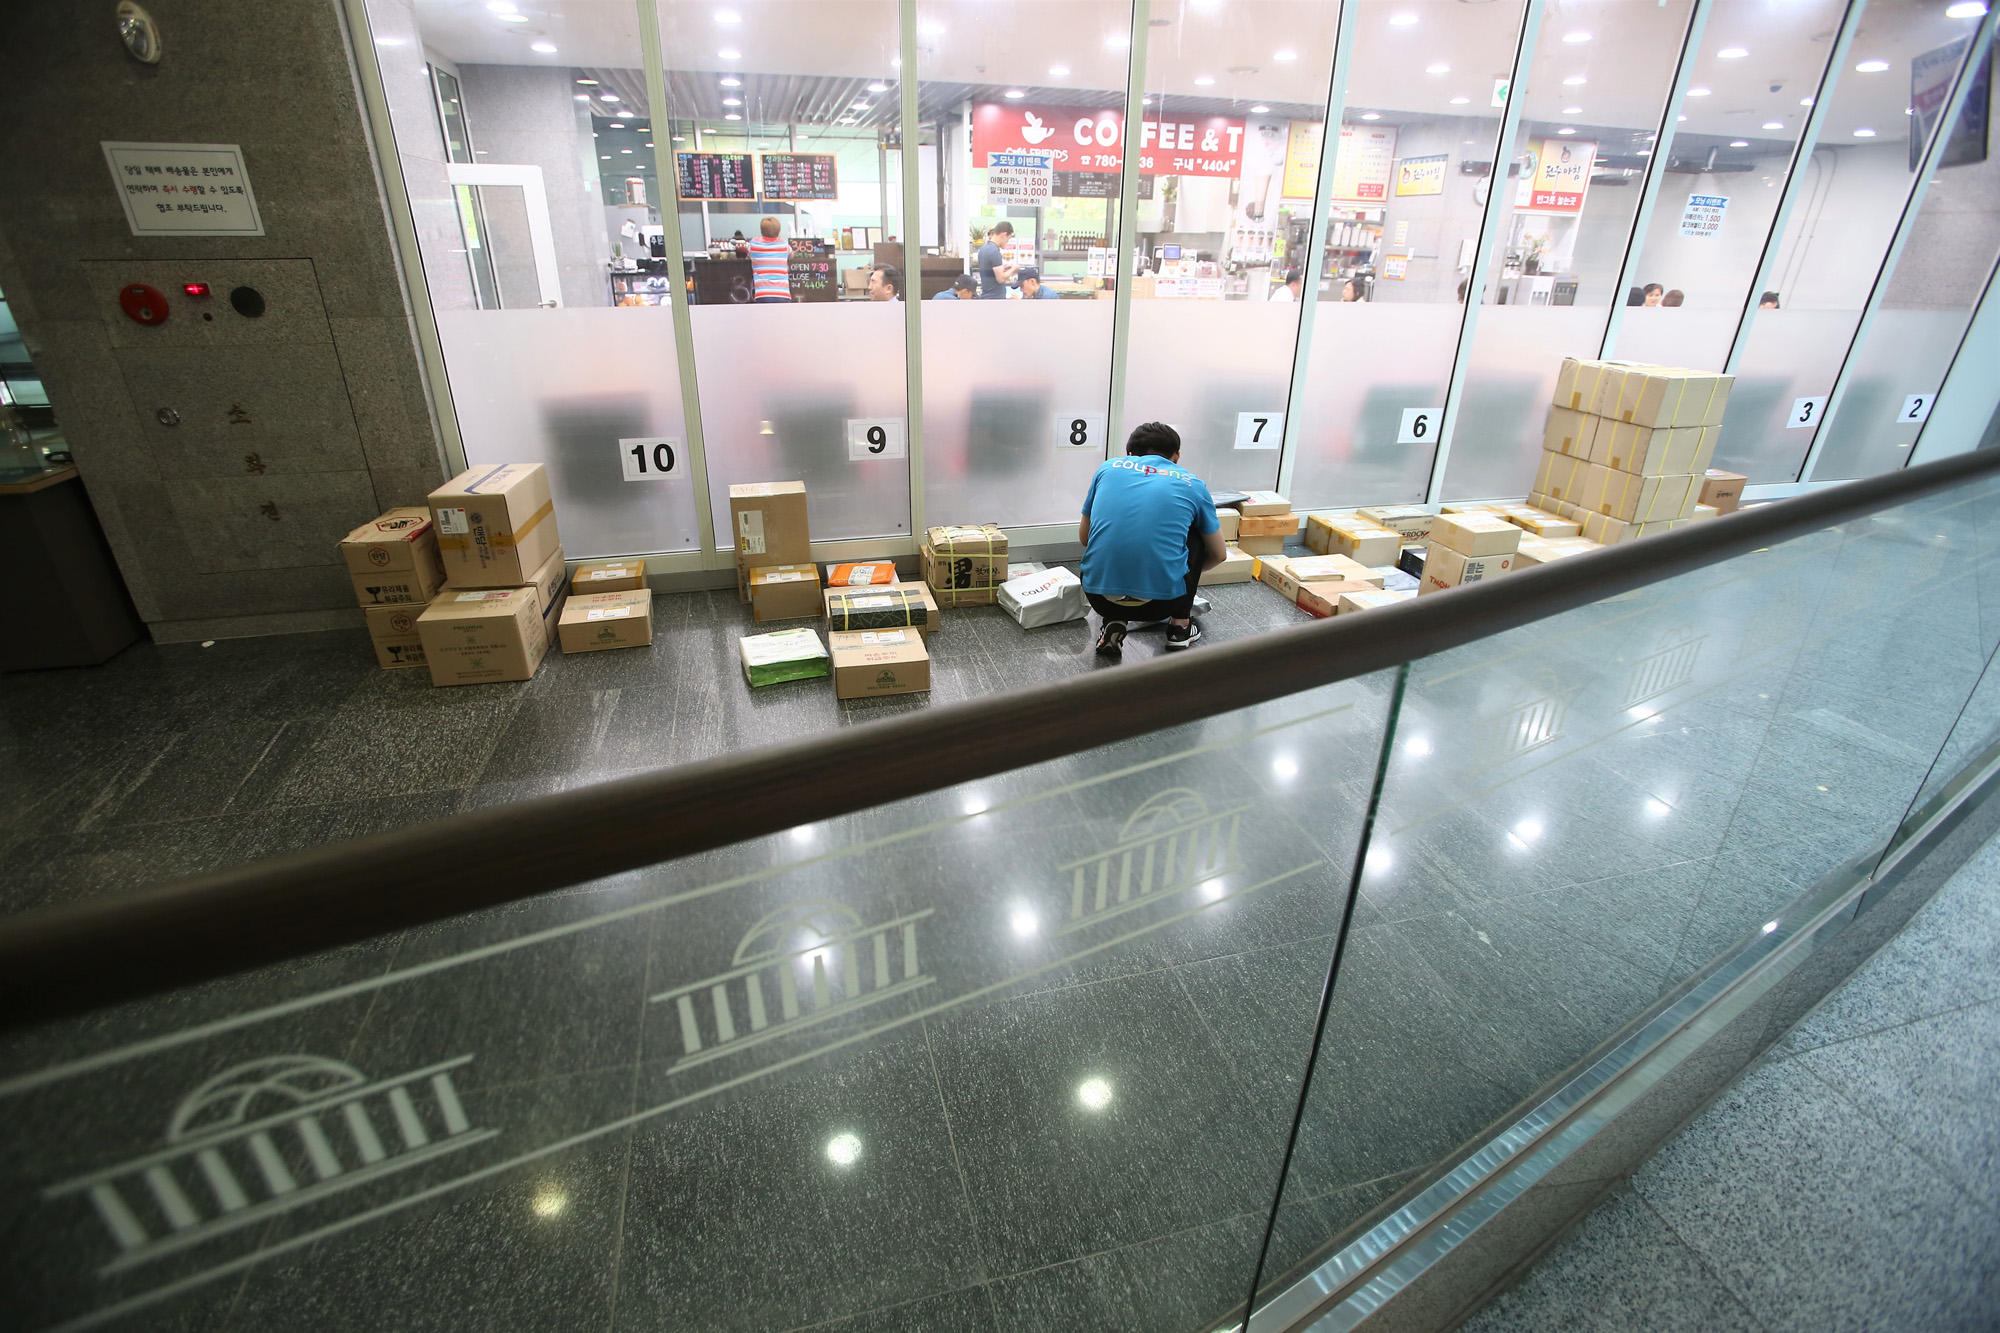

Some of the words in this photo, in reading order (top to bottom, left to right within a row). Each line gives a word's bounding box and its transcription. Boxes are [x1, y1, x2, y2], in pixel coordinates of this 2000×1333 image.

[1073, 117, 1195, 151] COFEE
[1201, 128, 1219, 152] &
[1226, 126, 1243, 153] T
[999, 156, 1015, 165] 모닝
[1018, 157, 1041, 166] 이벤트
[1095, 155, 1154, 168] 780-36
[1173, 158, 1194, 171] 구내
[125, 165, 142, 175] 당일
[145, 165, 162, 175] 택배
[166, 166, 198, 176] 배송물은
[203, 166, 234, 177] 본인에게
[990, 176, 1021, 185] 아메리카노
[1023, 177, 1048, 187] 1,500
[126, 184, 159, 195] 연락하여
[162, 185, 178, 195] 즉시
[182, 185, 206, 196] 수령할
[209, 186, 217, 194] 수
[221, 186, 244, 196] 있도록
[990, 186, 1020, 195] 밀크버블티
[1022, 187, 1047, 197] 3,000
[1536, 195, 1556, 204] 빈그릇
[157, 203, 174, 213] 협조
[177, 203, 227, 214] 부탁드립니다.
[792, 240, 814, 252] 365
[790, 263, 810, 271] OPEN
[789, 273, 810, 281] CLOSE
[1800, 402, 1814, 422] 3
[1909, 399, 1922, 417] 2
[1069, 419, 1087, 446] 8
[1252, 418, 1268, 443] 7
[1413, 415, 1428, 438] 6
[866, 425, 887, 454] 9
[631, 443, 675, 474] 10
[1113, 458, 1192, 487] coupang
[382, 585, 409, 593] 유리제품
[1021, 575, 1076, 597] coupang
[384, 593, 412, 603] 취급주의
[403, 645, 424, 654] 유리제
[406, 653, 426, 662] 취급주
